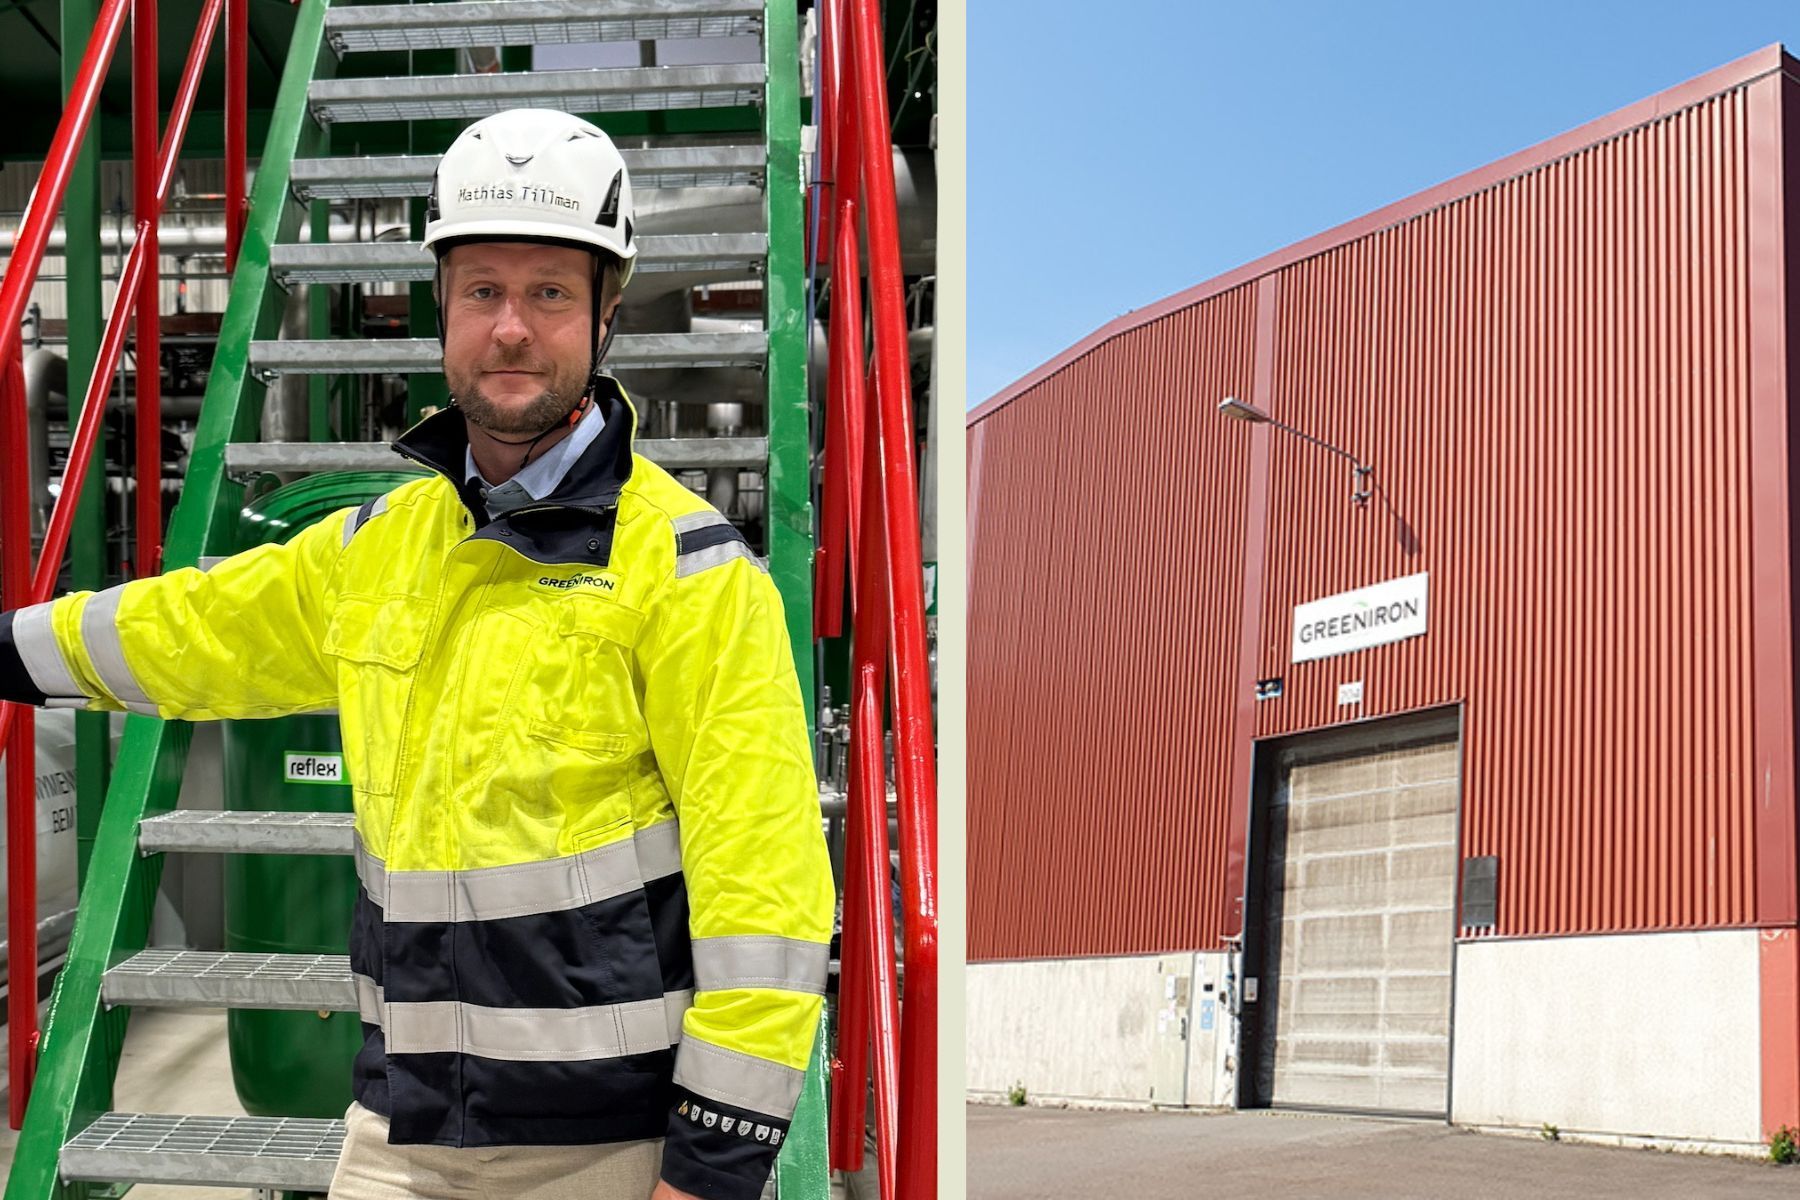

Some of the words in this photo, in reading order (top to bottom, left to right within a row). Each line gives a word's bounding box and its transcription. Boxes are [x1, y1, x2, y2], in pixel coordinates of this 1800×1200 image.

[458, 186, 513, 202] Mathias
[521, 186, 580, 210] Tillman
[538, 574, 614, 590] GREENIRON
[1299, 598, 1419, 643] GREENIRON
[291, 758, 336, 776] reflex
